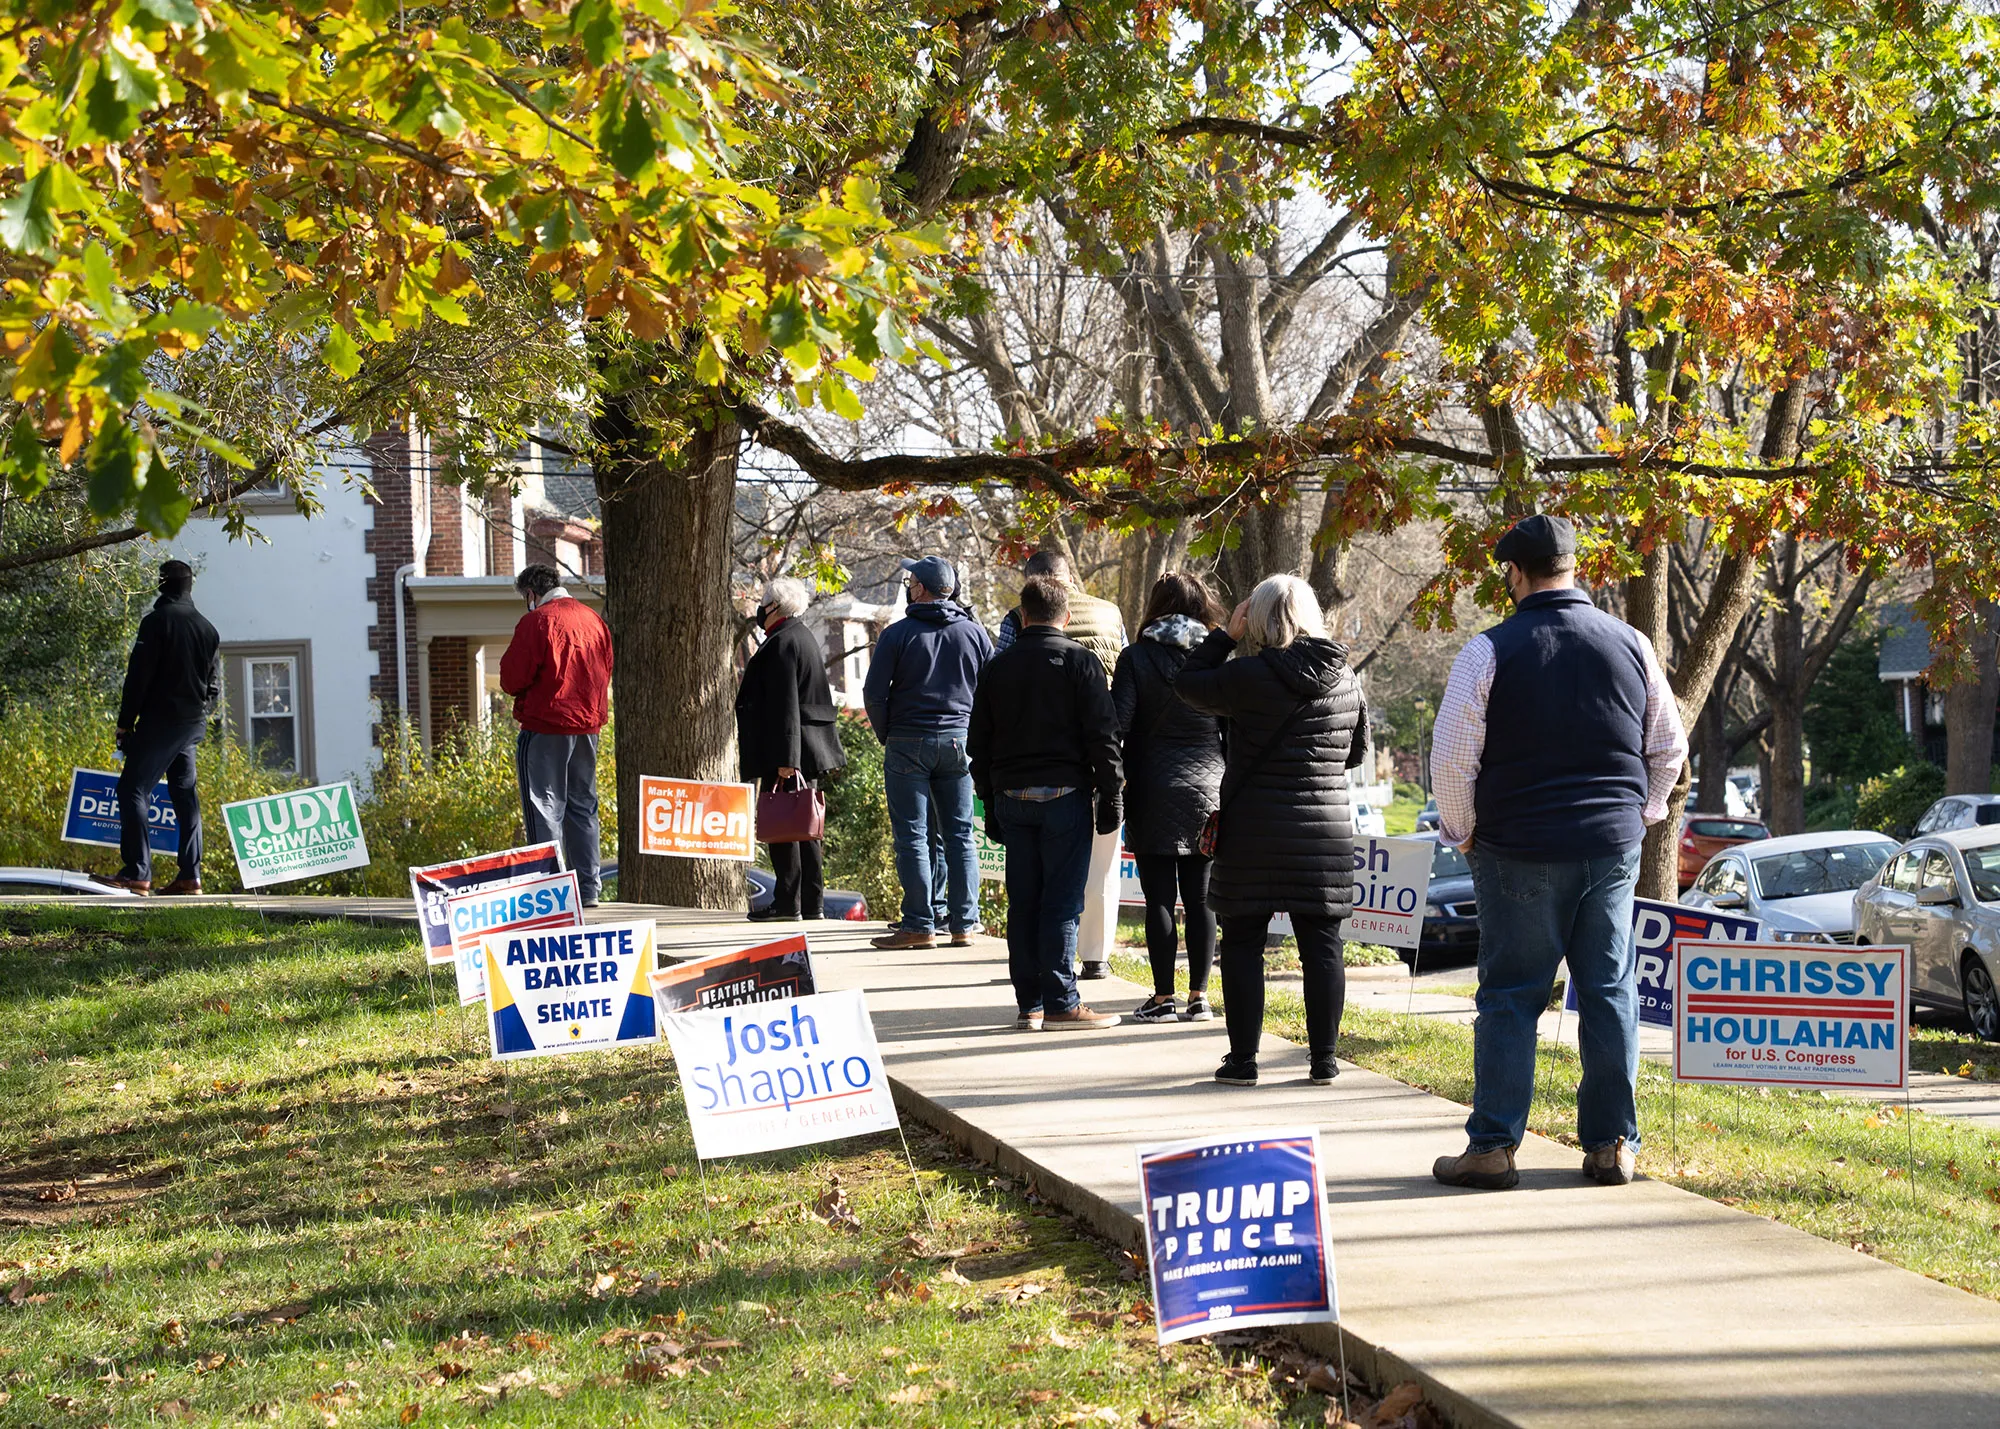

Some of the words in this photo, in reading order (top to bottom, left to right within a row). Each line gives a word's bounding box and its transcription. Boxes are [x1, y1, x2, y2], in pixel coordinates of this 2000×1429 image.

[648, 786, 673, 798] Mark
[676, 788, 689, 798] M.
[92, 821, 121, 830] AUDITO
[238, 788, 342, 839] JUDY
[646, 798, 748, 838] Gillen
[244, 820, 353, 857] SCHWANK
[647, 835, 672, 847] State
[674, 837, 747, 851] Representative
[248, 857, 271, 869] OUR
[273, 851, 303, 865] STATE
[306, 840, 356, 858] SENATOR
[261, 854, 348, 876] JudySchwank2020.com
[979, 851, 994, 861] UR
[454, 885, 570, 932] CHRISSY
[1351, 918, 1410, 935] GENERAL
[506, 929, 634, 966] ANNETTE
[524, 961, 619, 990] BAKER
[1686, 956, 1895, 996] CHRISSY
[565, 988, 578, 1001] for
[537, 998, 612, 1024] SENATE
[723, 1004, 820, 1066] Josh
[1687, 1016, 1895, 1050] HOULAHAN
[1726, 1048, 1747, 1060] for
[1751, 1049, 1780, 1062] U.S.
[1785, 1050, 1856, 1066] Congress
[691, 1052, 872, 1112] Shapiro
[800, 1103, 880, 1128] GENERAL
[1152, 1180, 1310, 1231] TRUMP
[1164, 1222, 1295, 1260] PENCE
[1163, 1267, 1183, 1282] MAKE
[1184, 1261, 1223, 1279] AMERICA
[1223, 1257, 1258, 1271] GREAT
[1260, 1254, 1302, 1267] AGAIN!
[1208, 1304, 1233, 1320] 2020
